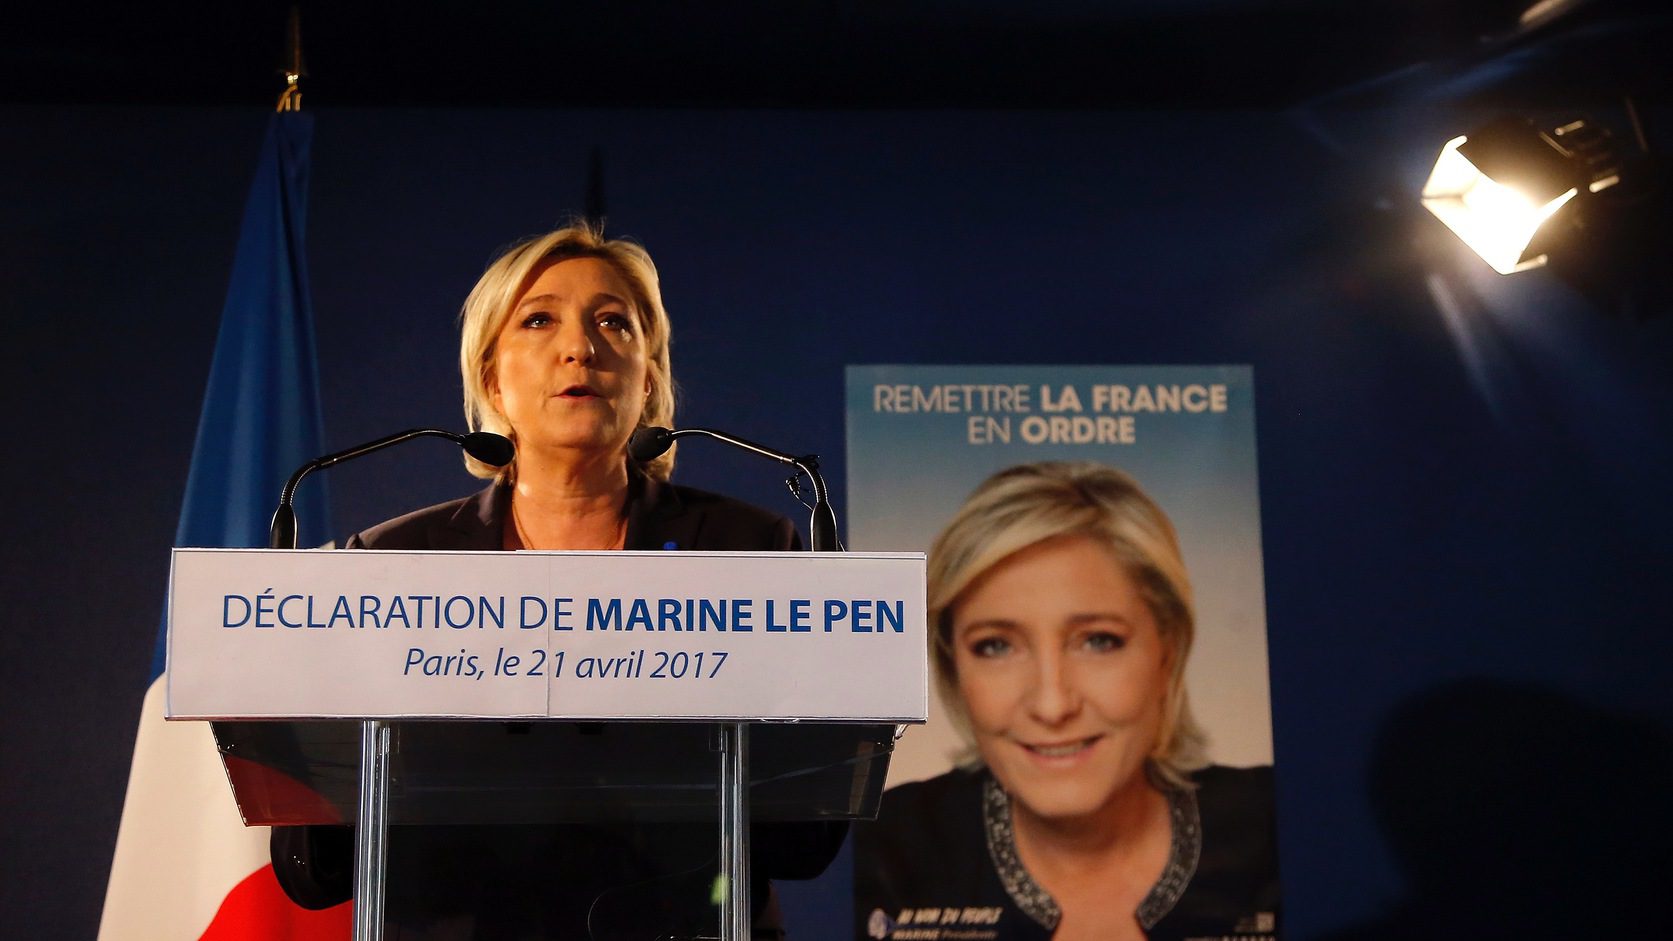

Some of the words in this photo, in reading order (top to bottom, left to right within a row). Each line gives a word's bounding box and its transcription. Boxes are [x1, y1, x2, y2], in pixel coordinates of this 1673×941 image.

[874, 385, 1030, 412] REMETTRE
[1041, 385, 1082, 412] LA
[1093, 384, 1227, 412] FRANCE
[967, 416, 1011, 444] EN
[1020, 416, 1136, 444] ORDRE
[222, 587, 505, 630] DÉCLARATION
[519, 597, 574, 631] DE
[586, 598, 754, 633] MARINE
[765, 599, 812, 633] LE
[824, 599, 904, 633] PEN
[403, 648, 485, 680] Paris,
[494, 648, 521, 677] le
[526, 649, 565, 678] 21
[575, 649, 645, 679] avril
[649, 651, 729, 679] 2017
